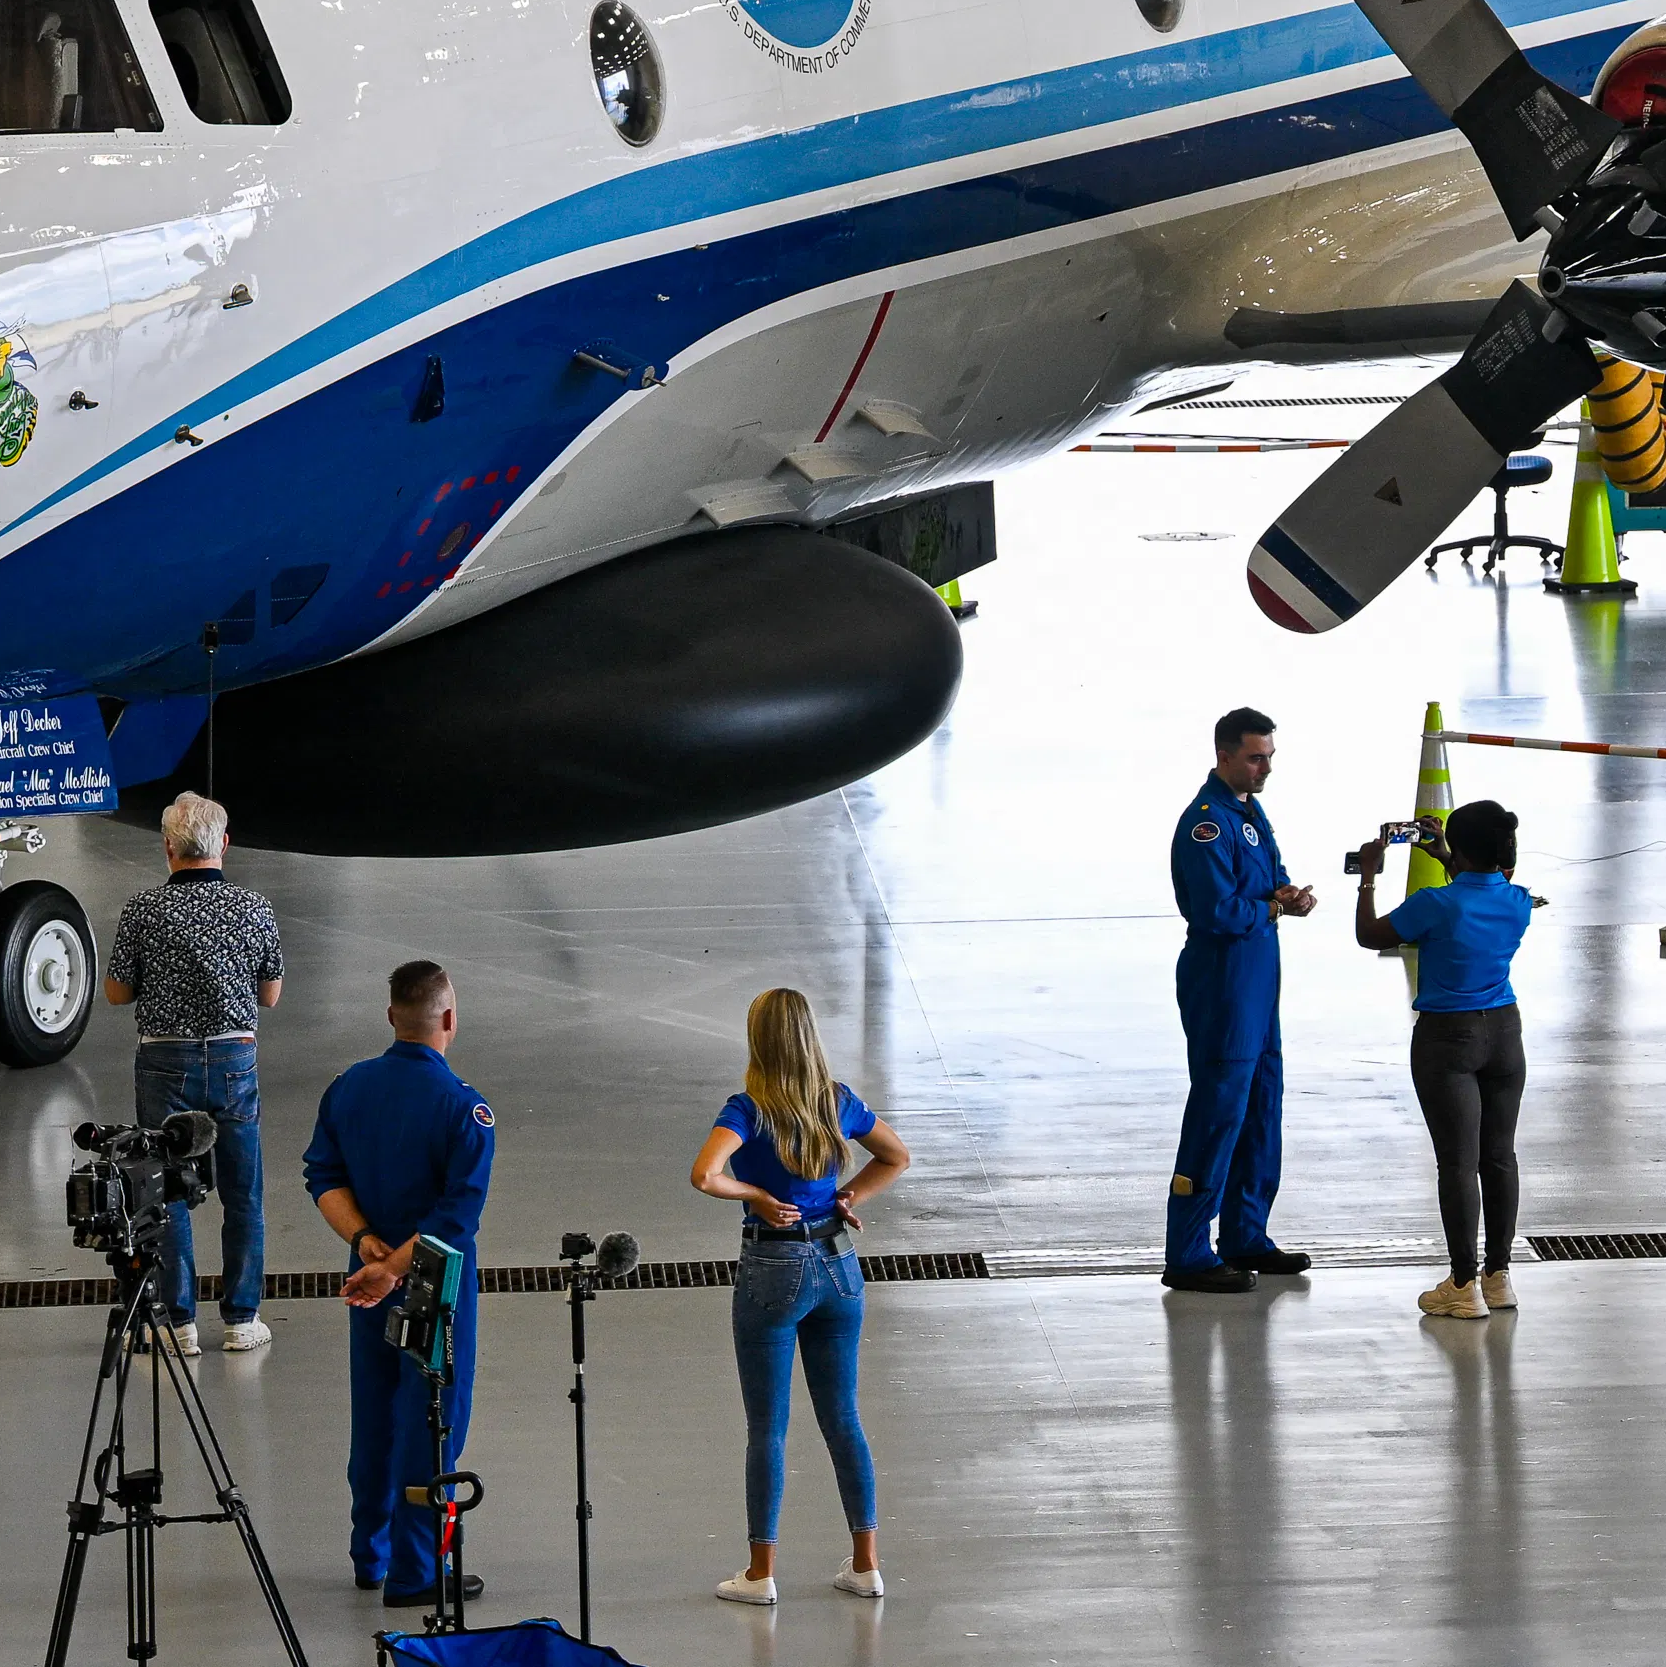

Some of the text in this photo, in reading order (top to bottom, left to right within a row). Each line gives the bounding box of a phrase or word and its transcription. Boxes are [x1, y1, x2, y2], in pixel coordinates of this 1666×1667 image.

[744, 21, 823, 74] DEPARTMENT
[825, 46, 841, 69] OF
[21, 707, 62, 732] Decker
[27, 744, 50, 757] Crew
[52, 740, 75, 756] Chief
[22, 768, 54, 792] "Mac"
[15, 792, 57, 811] Specialist
[58, 791, 80, 805] Crew
[82, 789, 104, 804] Chief
